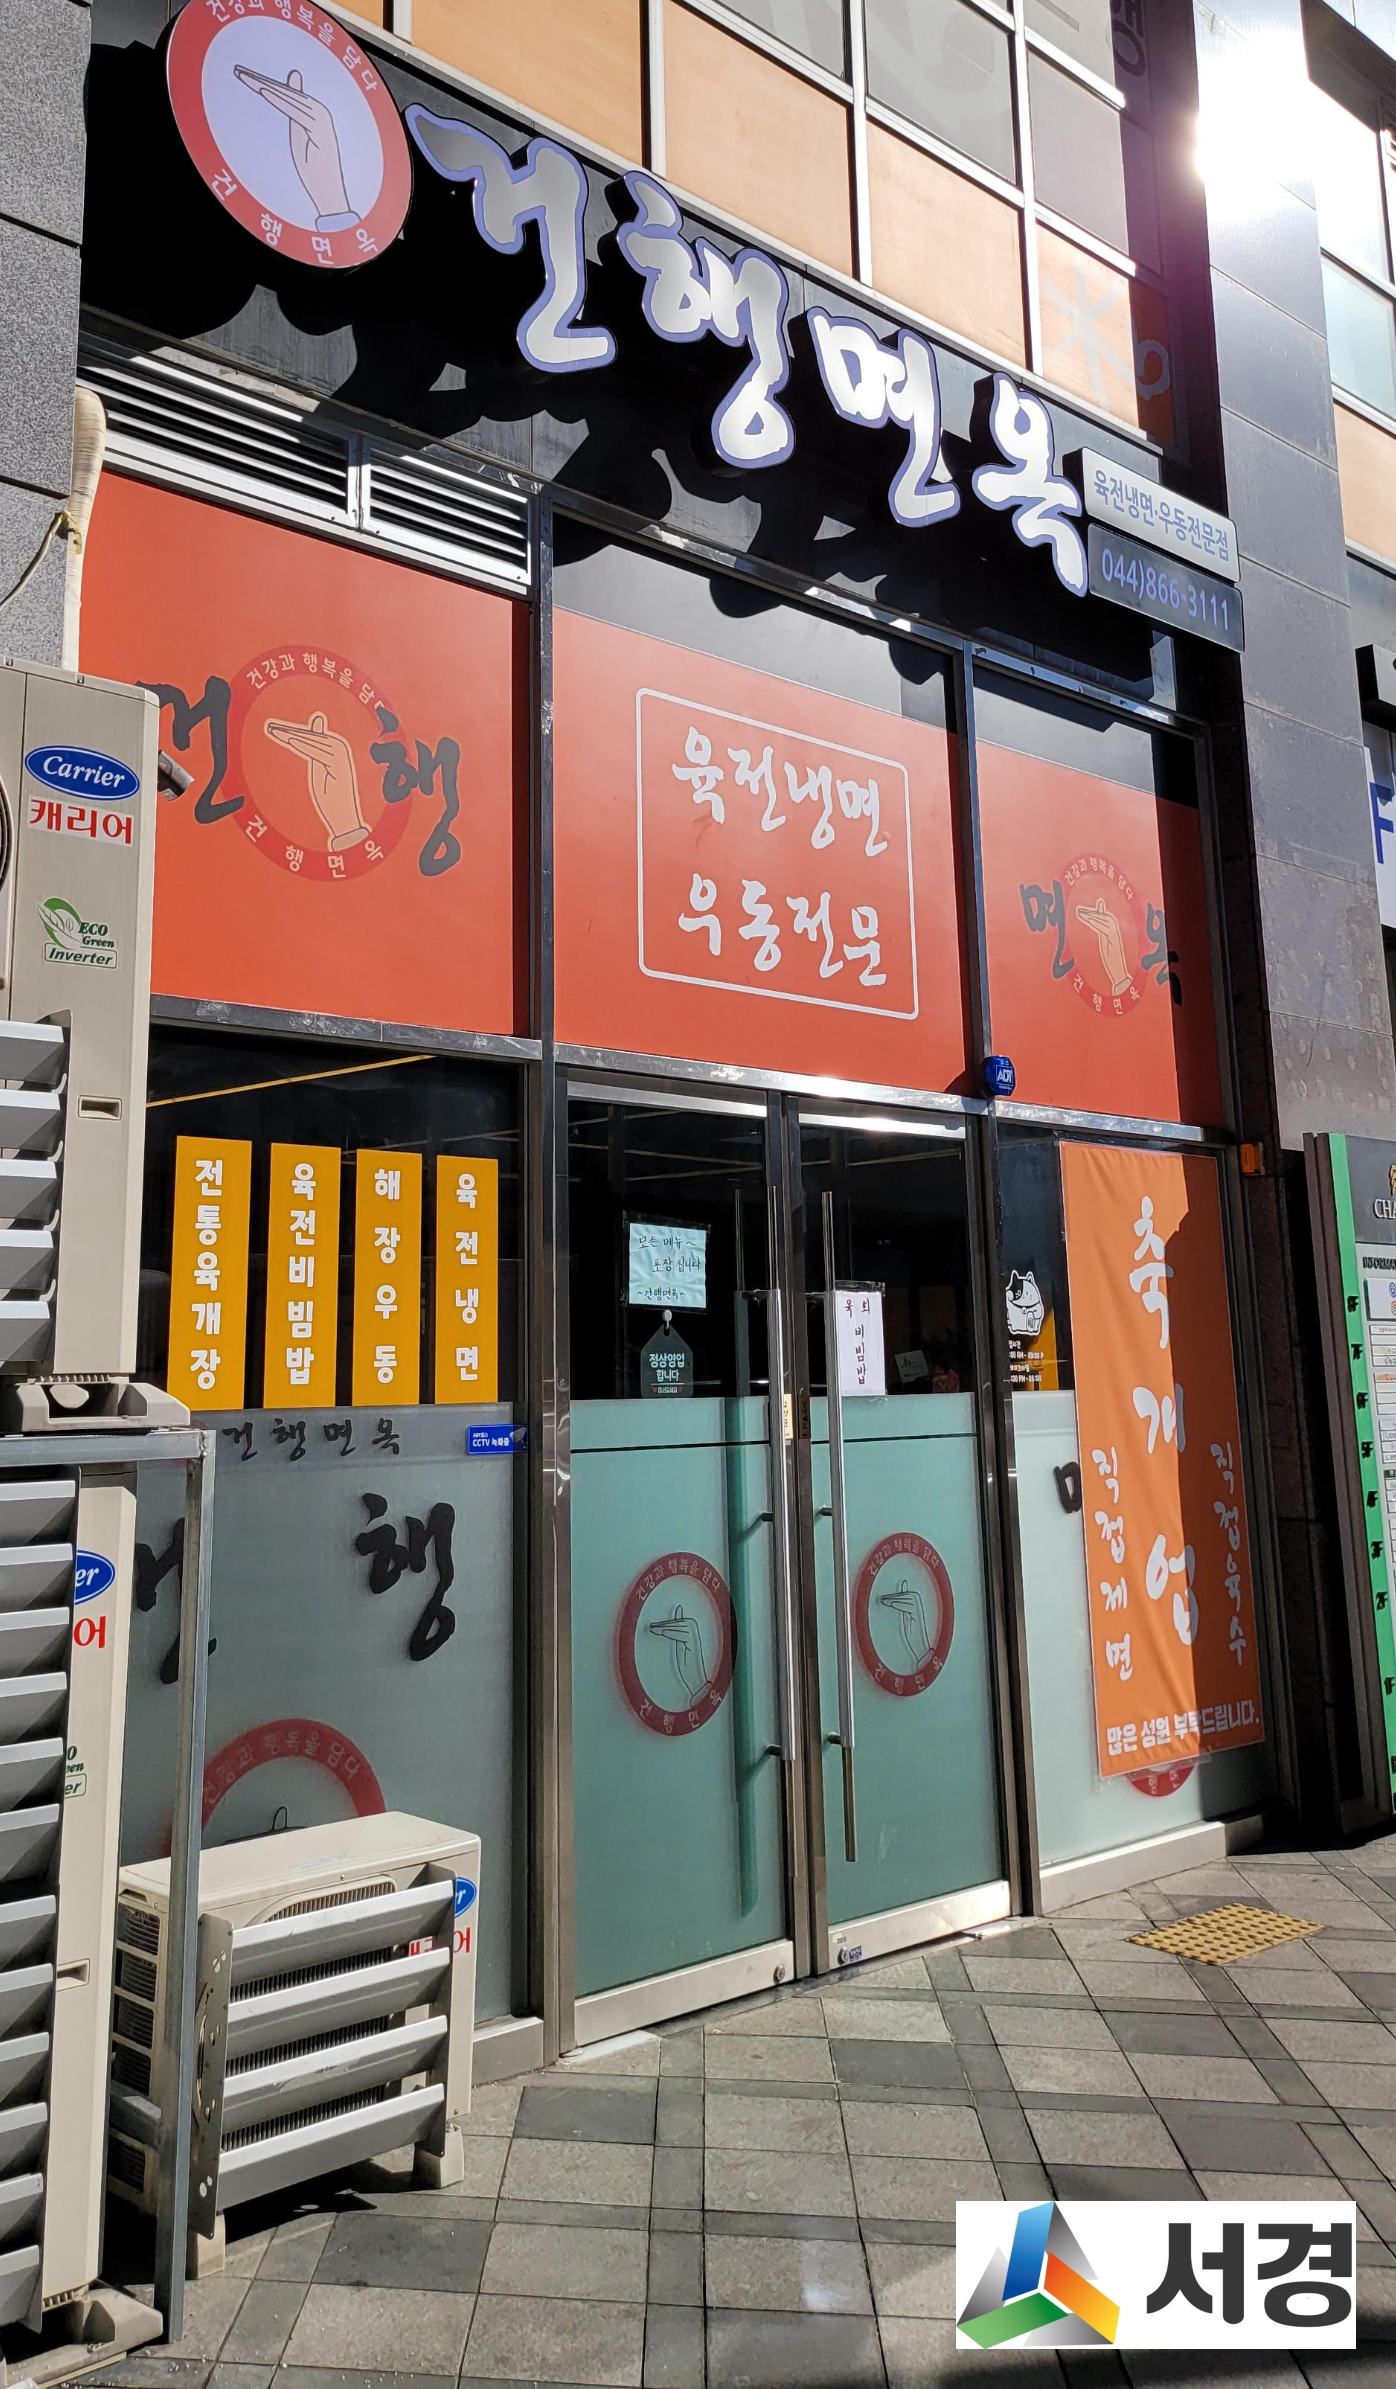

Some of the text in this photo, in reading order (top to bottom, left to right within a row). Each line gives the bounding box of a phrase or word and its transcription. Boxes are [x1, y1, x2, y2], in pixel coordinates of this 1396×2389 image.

[342, 45, 378, 91] 담다
[211, 168, 378, 265] 건행면옥
[405, 103, 1089, 598] 건행면옥
[1101, 548, 1229, 631] 044)866-3111
[246, 652, 385, 710] 건강과 행복을 담
[43, 755, 125, 789] Carrier
[672, 726, 888, 857] 육전냉면
[29, 798, 132, 845] 캐리어
[245, 814, 383, 879] 건행면옥
[1064, 856, 1134, 900] 건강과 행복을 담다
[78, 921, 109, 937] ECO
[82, 935, 115, 949] Green
[678, 873, 887, 987] 우동전문
[49, 947, 114, 967] Inverter
[1073, 973, 1140, 1015] 건행면옥
[996, 1068, 1013, 1083] ADT
[638, 1234, 683, 1250] 모든 메뉴
[189, 1159, 223, 1390] 전통육개장
[285, 1163, 317, 1385] 육전비빔밥
[373, 1168, 401, 1384] 해장우동
[454, 1173, 479, 1381] 육전냉면
[652, 1256, 701, 1273] 포장 됩니다
[844, 1298, 871, 1319] 육회
[649, 1352, 685, 1368] 정상영업
[656, 1368, 680, 1382] 합니다
[855, 1324, 868, 1386] 비빔밥
[472, 1438, 491, 1447] CCTV
[867, 1538, 940, 1576] 건강과 행복을 담다
[635, 1558, 720, 1601] 건강과 행복을 담다
[874, 1656, 944, 1694] 건행면옥
[640, 1690, 722, 1734] 건행면옥
[1107, 1699, 1260, 1756] 많은 성원 부탁드립니다.
[263, 1730, 322, 1757] 행복을
[327, 1742, 360, 1780] 담다
